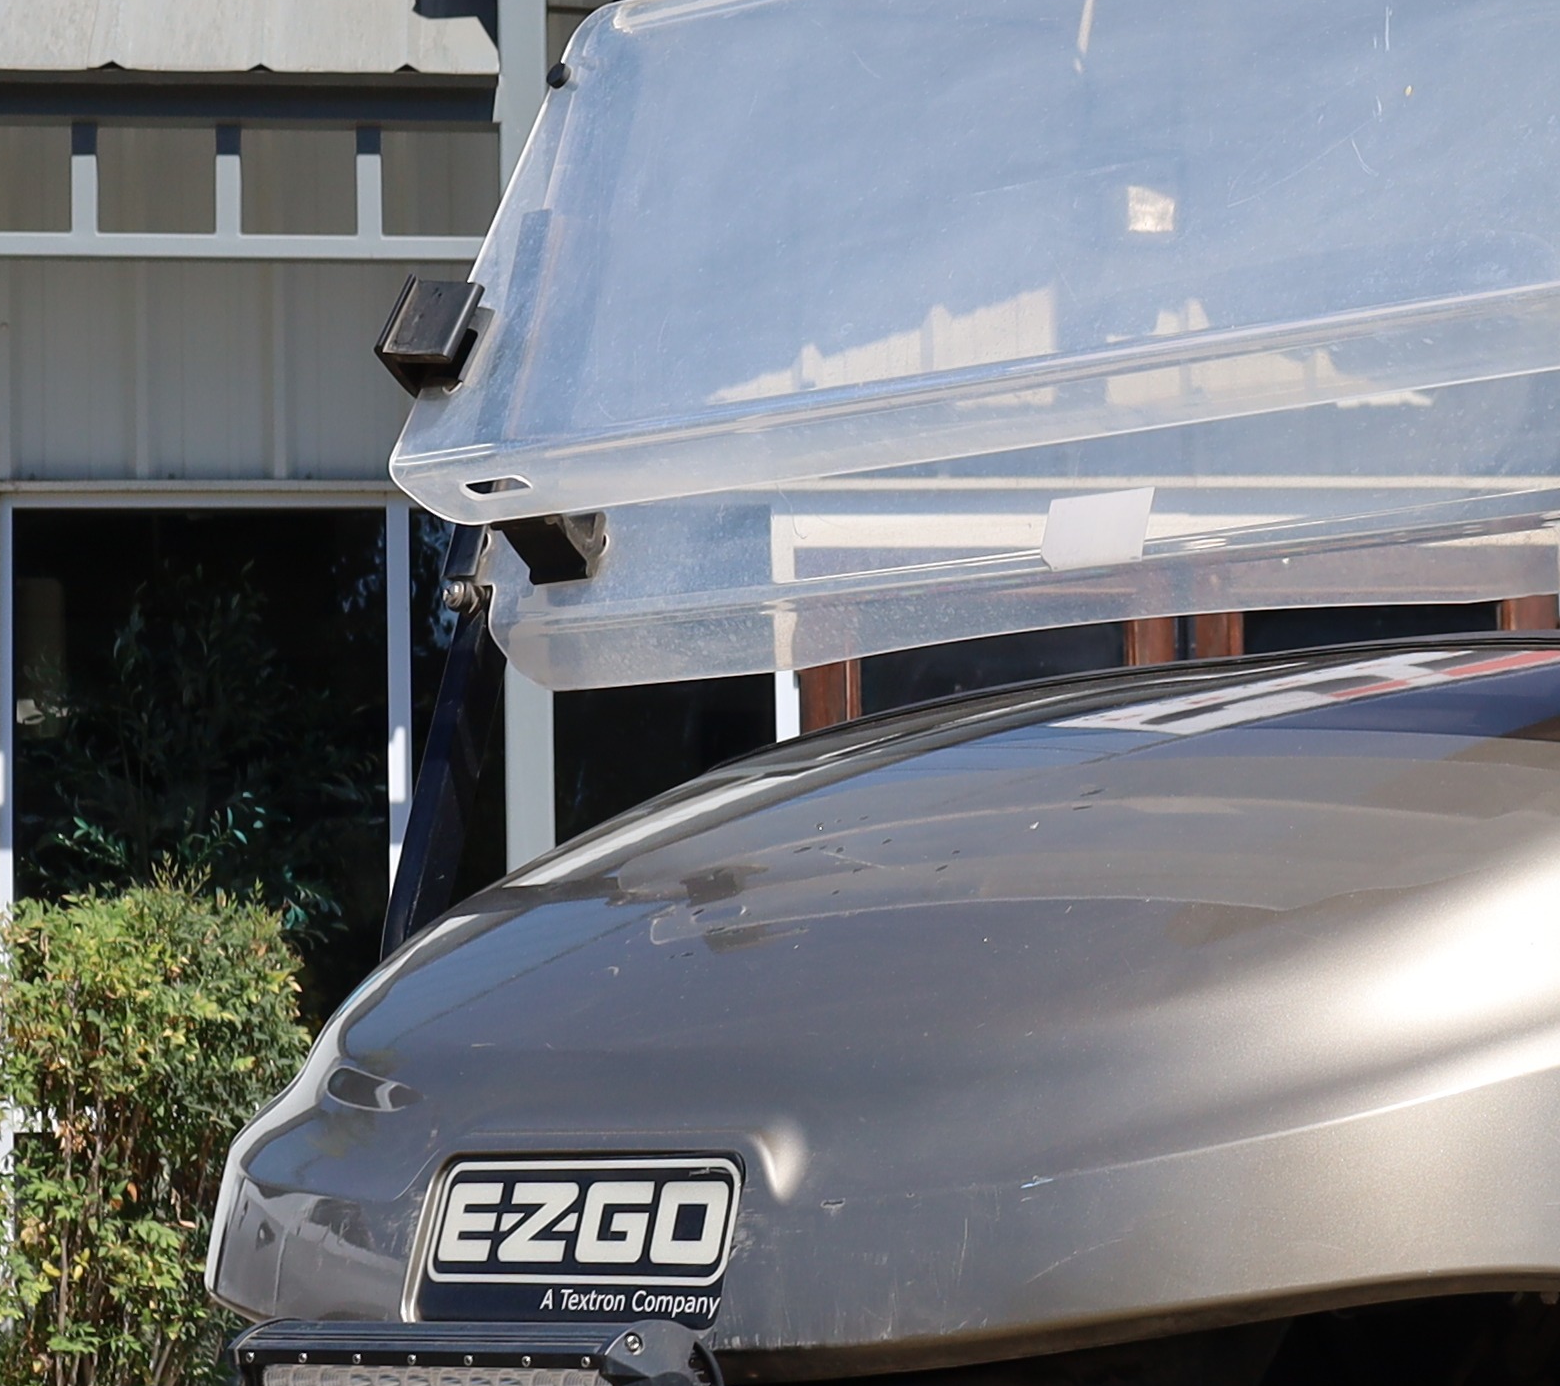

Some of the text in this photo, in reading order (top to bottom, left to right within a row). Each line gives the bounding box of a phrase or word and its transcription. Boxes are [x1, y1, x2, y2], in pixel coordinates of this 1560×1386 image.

[437, 1181, 730, 1265] EZGO
[539, 1288, 721, 1320] A Textron Company
